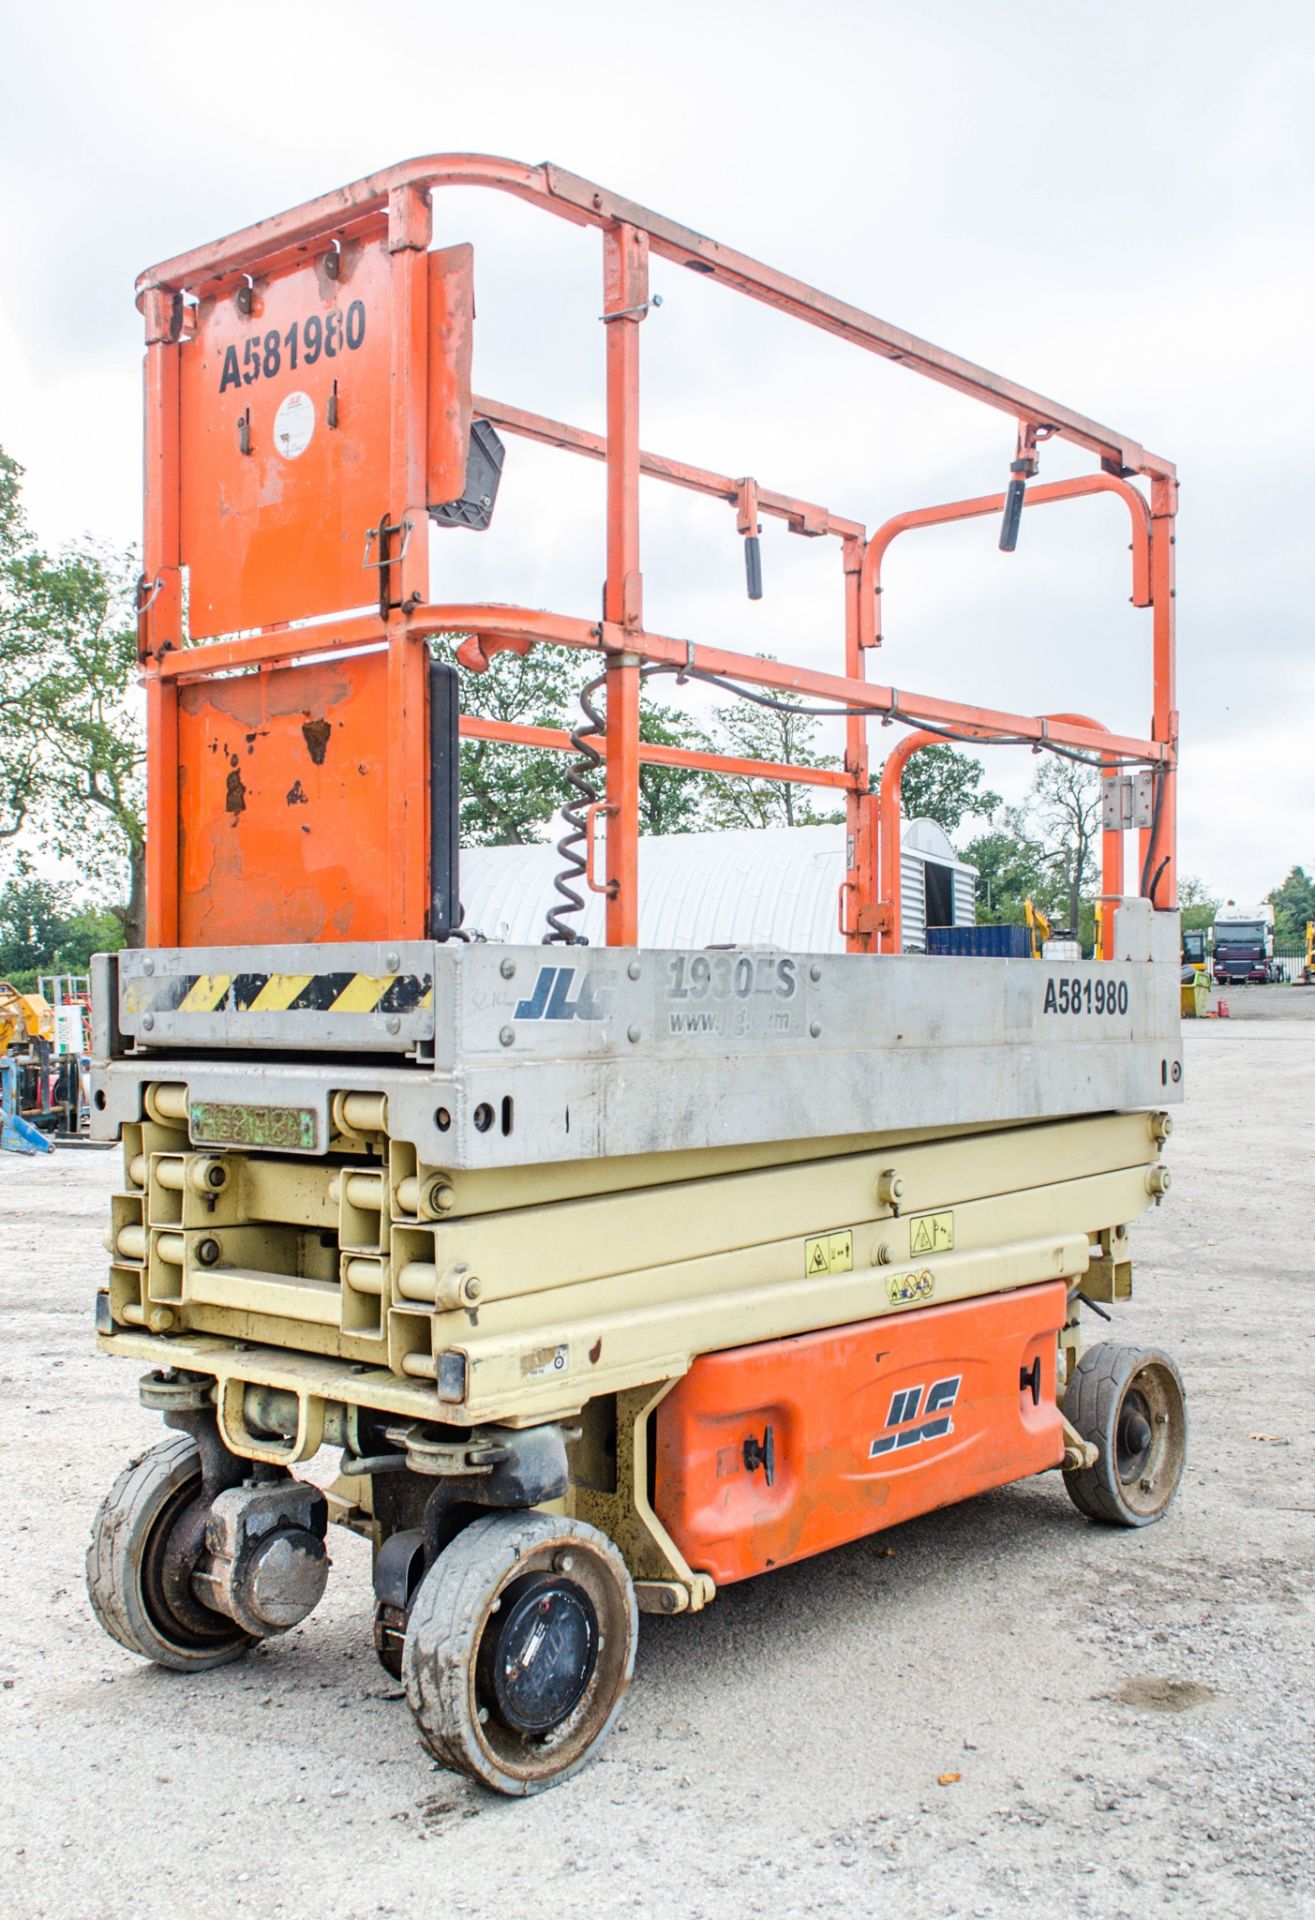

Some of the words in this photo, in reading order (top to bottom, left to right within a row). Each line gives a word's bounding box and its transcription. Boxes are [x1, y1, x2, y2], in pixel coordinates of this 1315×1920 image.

[219, 300, 366, 394] A581980
[1043, 978, 1129, 1015] A581980
[868, 1373, 963, 1459] JLG
